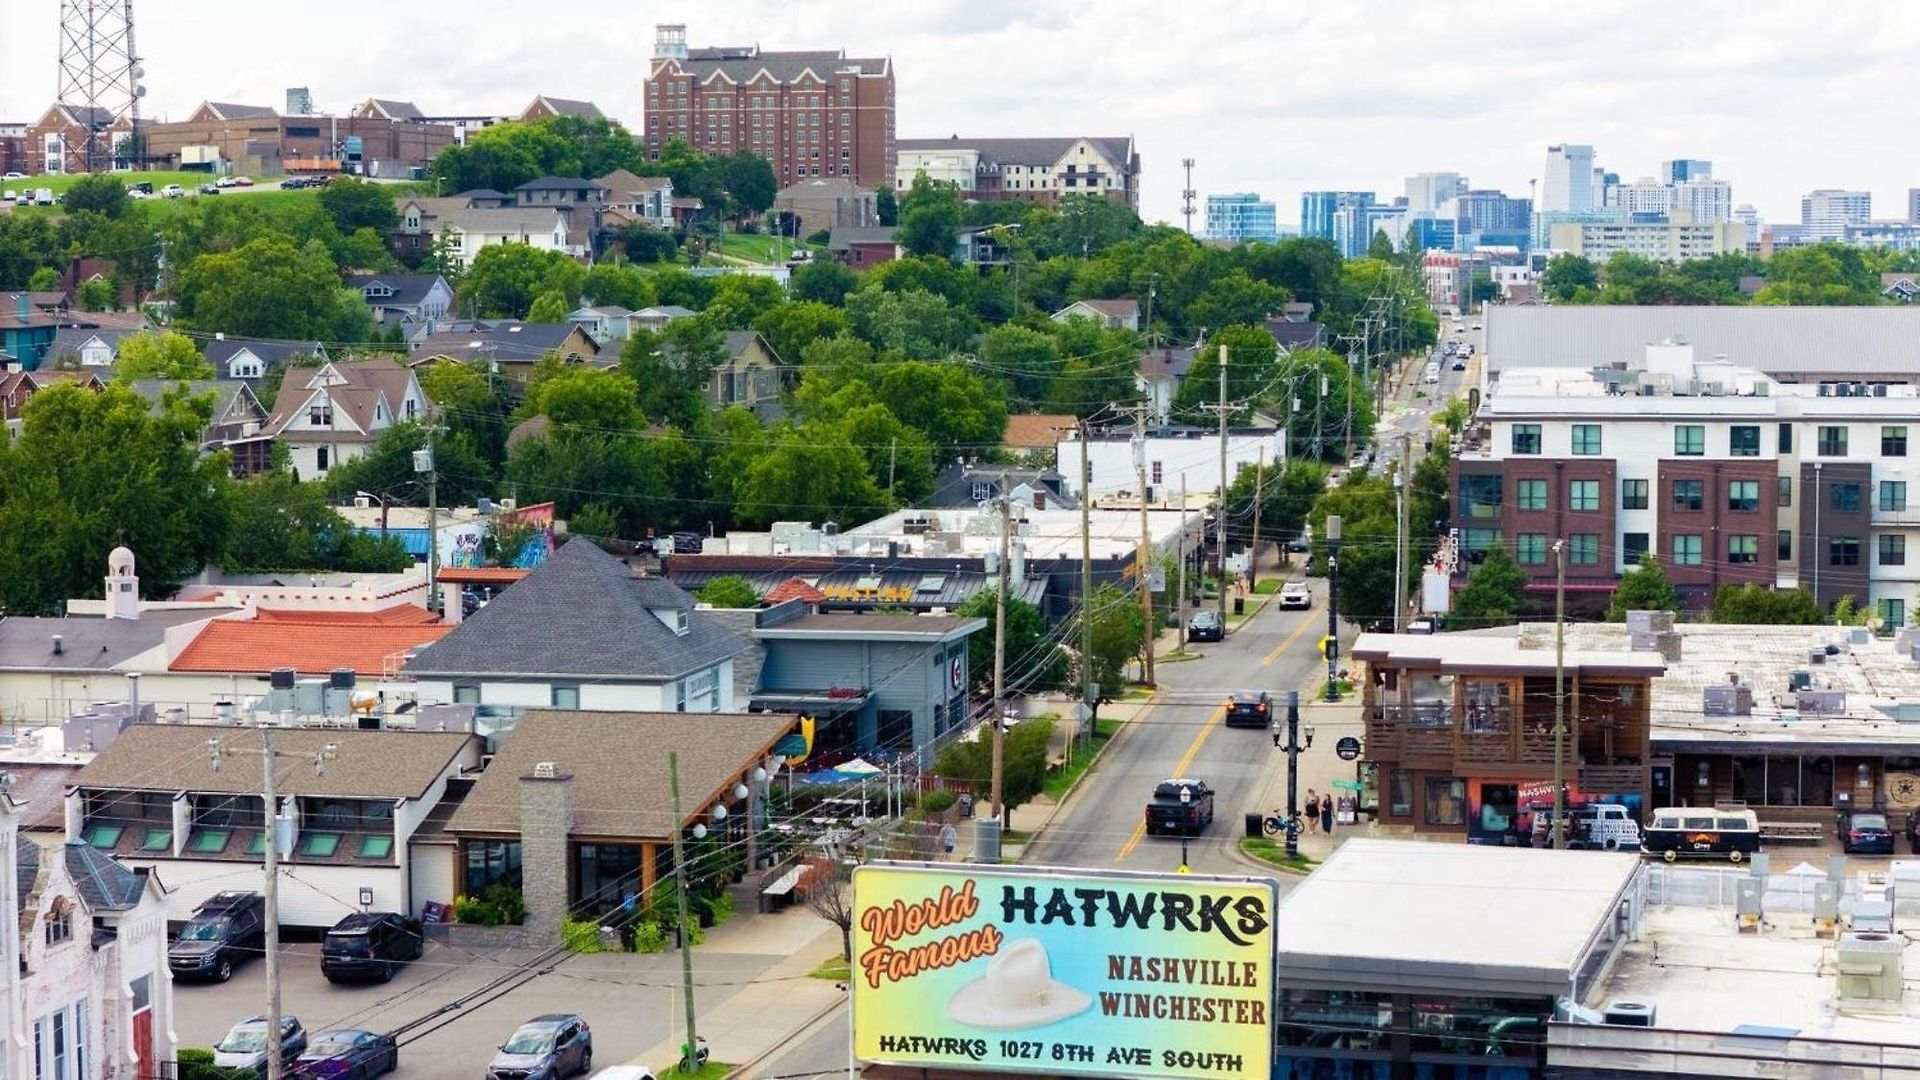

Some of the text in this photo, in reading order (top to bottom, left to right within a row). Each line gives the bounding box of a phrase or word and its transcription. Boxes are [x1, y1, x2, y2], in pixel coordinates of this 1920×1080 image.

[1450, 528, 1459, 574] FONDA
[1518, 782, 1571, 798] NASHVILE
[861, 879, 979, 944] World
[1000, 885, 1268, 946] HATWRKS
[861, 924, 1003, 988] Famous
[1108, 955, 1257, 987] NASHVILLE
[1099, 992, 1266, 1025] WINCHESTER
[879, 1035, 1242, 1071] HATWRKS 1027 8TH AVE SOUTH
